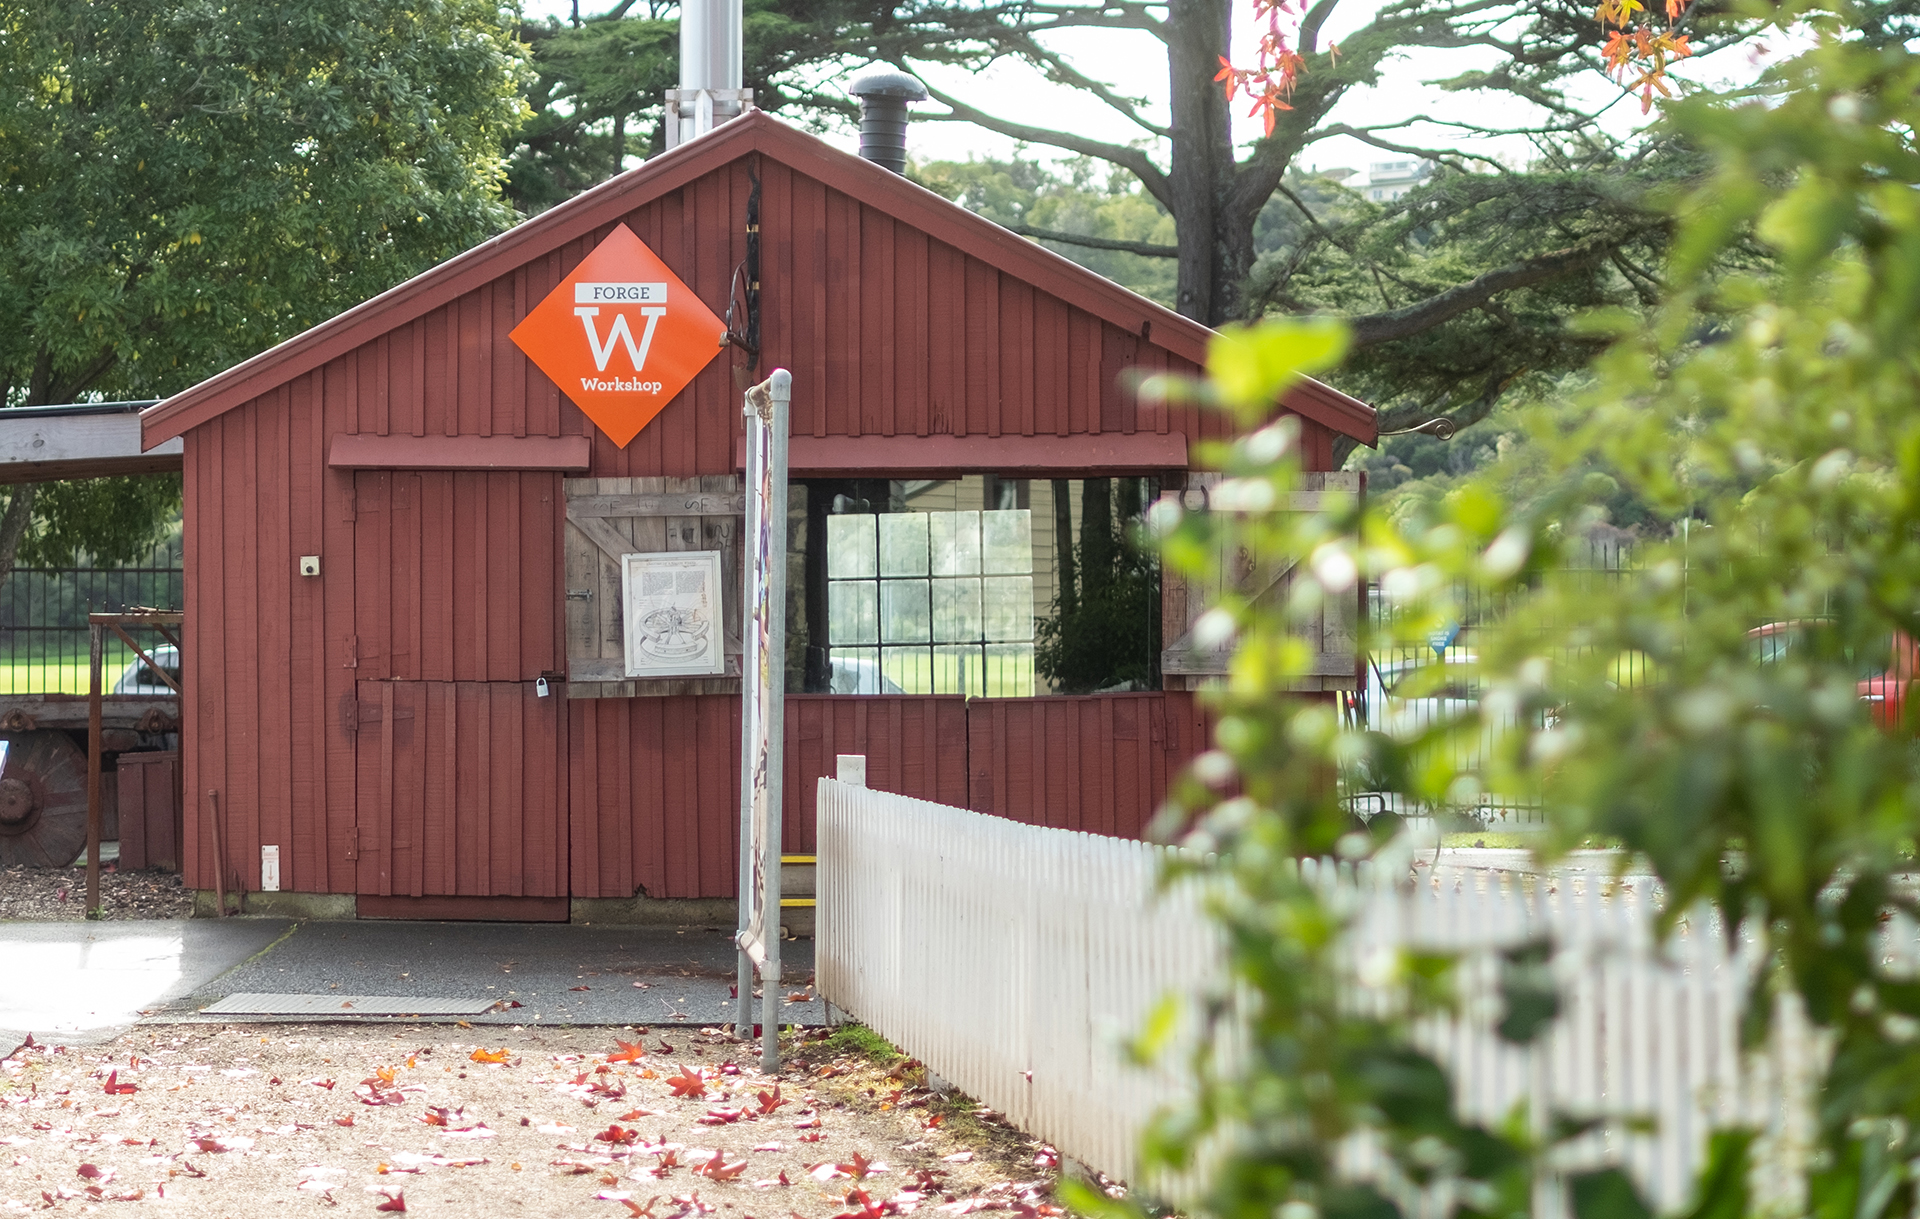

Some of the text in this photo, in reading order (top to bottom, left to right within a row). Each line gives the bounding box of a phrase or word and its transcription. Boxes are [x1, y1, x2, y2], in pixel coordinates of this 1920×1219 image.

[593, 286, 650, 300] FORGE
[573, 306, 667, 372] W
[580, 376, 662, 395] Workshop
